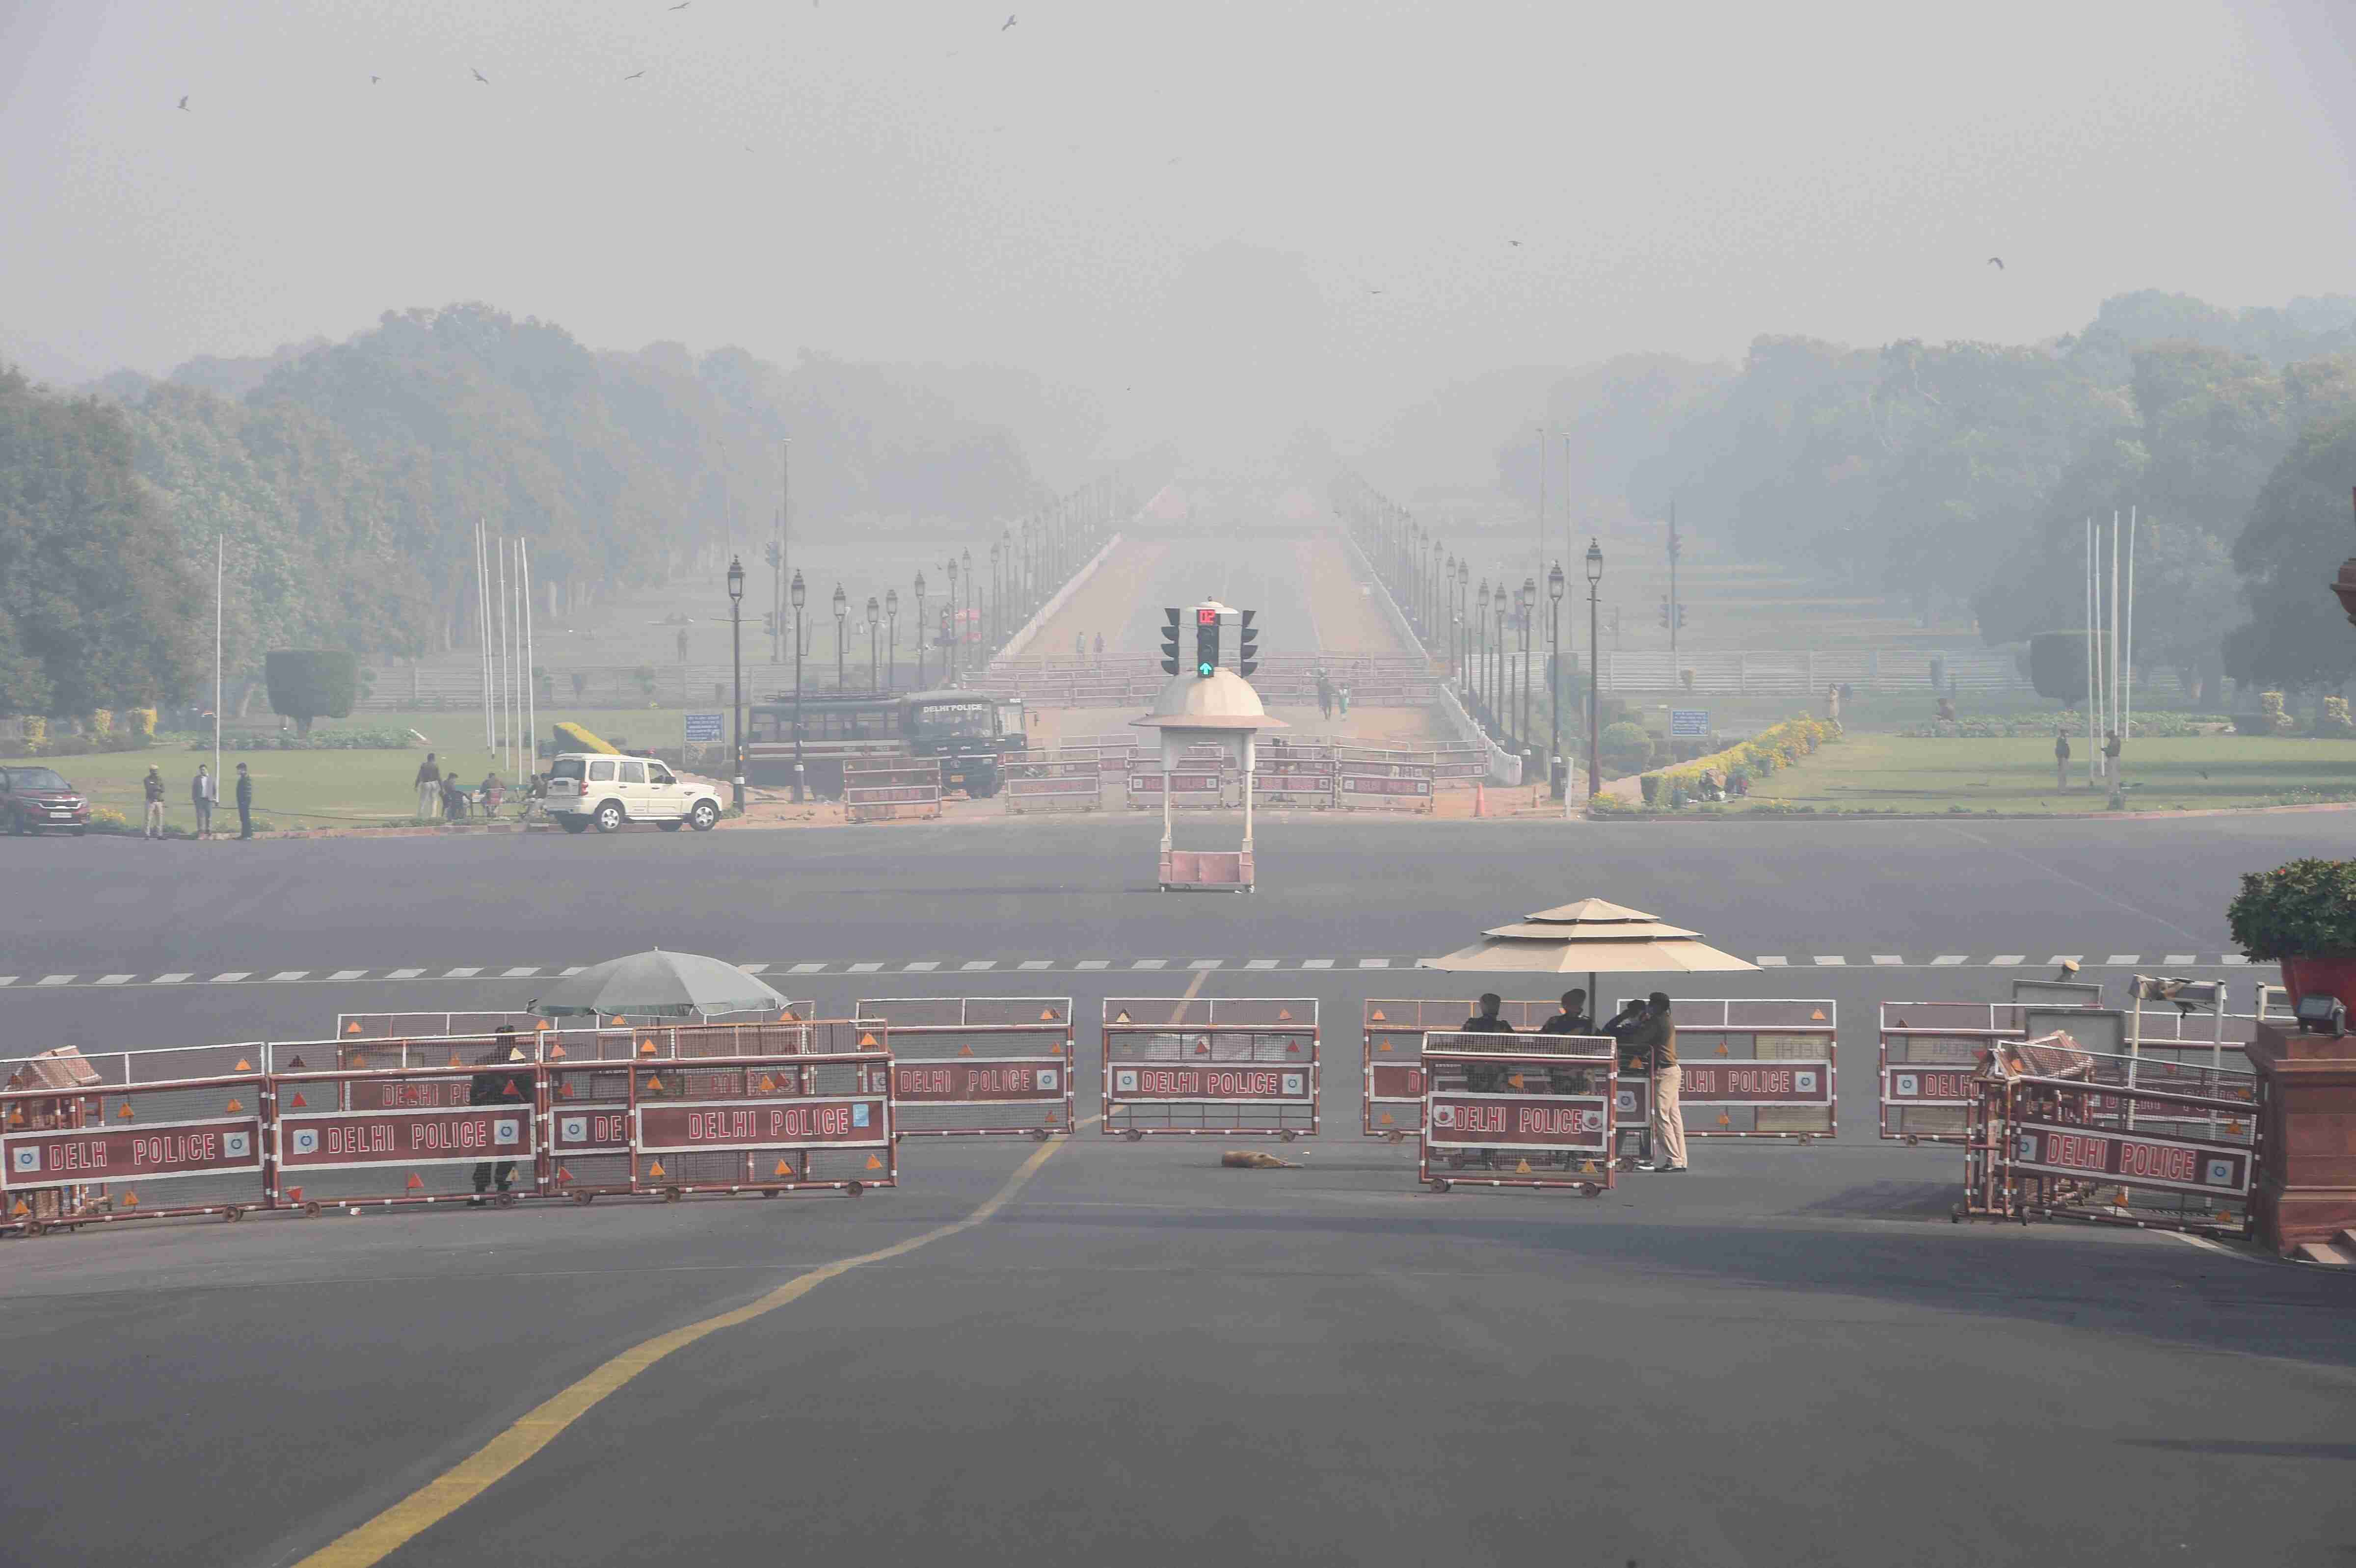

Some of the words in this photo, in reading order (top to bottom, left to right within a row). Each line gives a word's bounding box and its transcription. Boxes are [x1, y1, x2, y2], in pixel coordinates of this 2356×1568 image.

[900, 1070, 951, 1092] DELHI
[968, 1069, 1030, 1091] POLICE
[1142, 1071, 1199, 1093] DELHI
[1207, 1072, 1277, 1094] POLICE
[1678, 1071, 1715, 1093] ELHI
[1728, 1071, 1790, 1093] POLICE
[689, 1111, 756, 1139] DELHI
[771, 1108, 848, 1136] POLICE
[1454, 1106, 1506, 1132] DELHI
[1520, 1107, 1582, 1134] POLICE
[328, 1125, 395, 1153] DELHI
[411, 1120, 487, 1149] POLICE
[49, 1142, 107, 1171] DELH
[133, 1133, 215, 1166] POLICE
[2046, 1133, 2109, 1170] DELHI
[2120, 1142, 2196, 1181] POLICE
